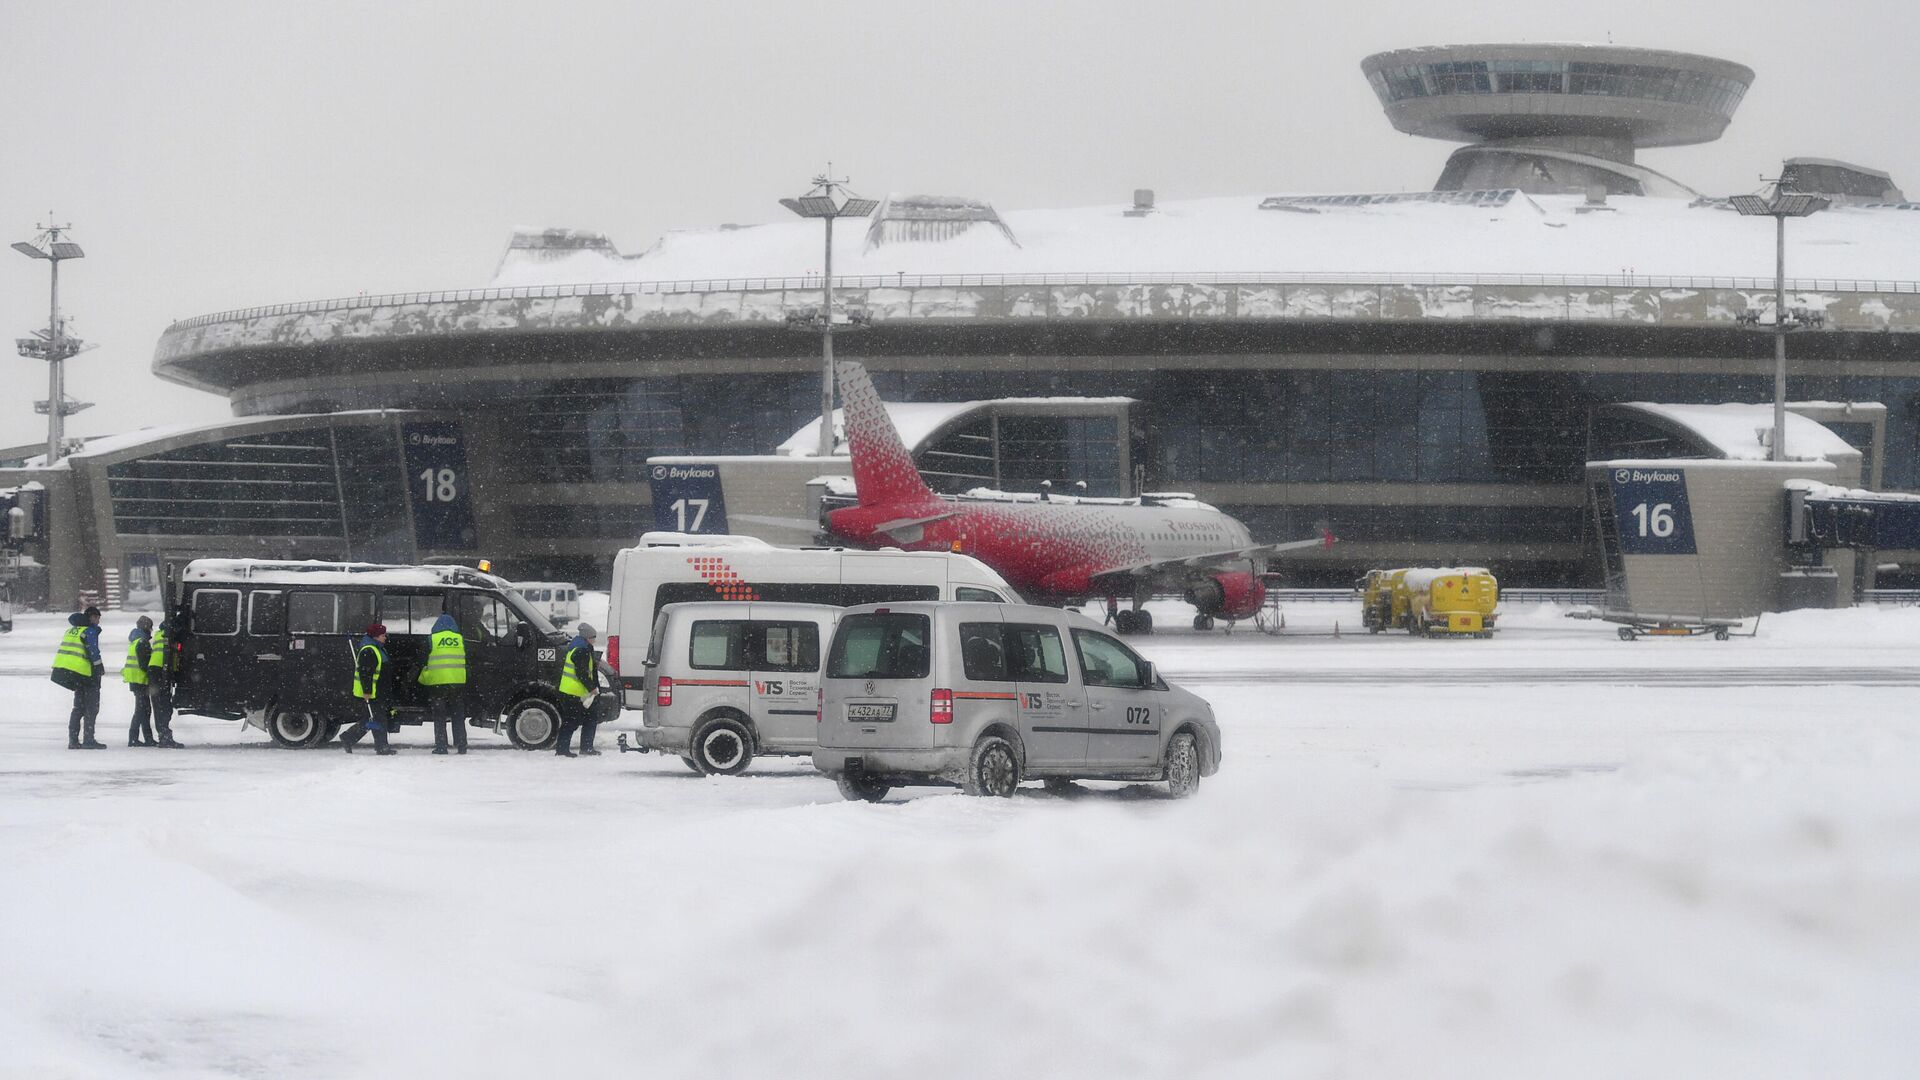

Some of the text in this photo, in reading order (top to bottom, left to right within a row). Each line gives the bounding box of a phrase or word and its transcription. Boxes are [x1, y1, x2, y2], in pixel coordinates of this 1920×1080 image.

[422, 434, 457, 446] Внуково
[670, 467, 715, 480] Внуково
[1632, 470, 1679, 484] Внуково
[420, 468, 456, 502] 18
[670, 498, 709, 532] 17
[1631, 502, 1674, 538] 16
[1178, 522, 1222, 532] ROSSIYA
[437, 637, 459, 646] AGS
[538, 649, 555, 661] 32
[755, 680, 783, 695] VTS
[1018, 692, 1043, 709] VTS
[1126, 706, 1150, 725] 072
